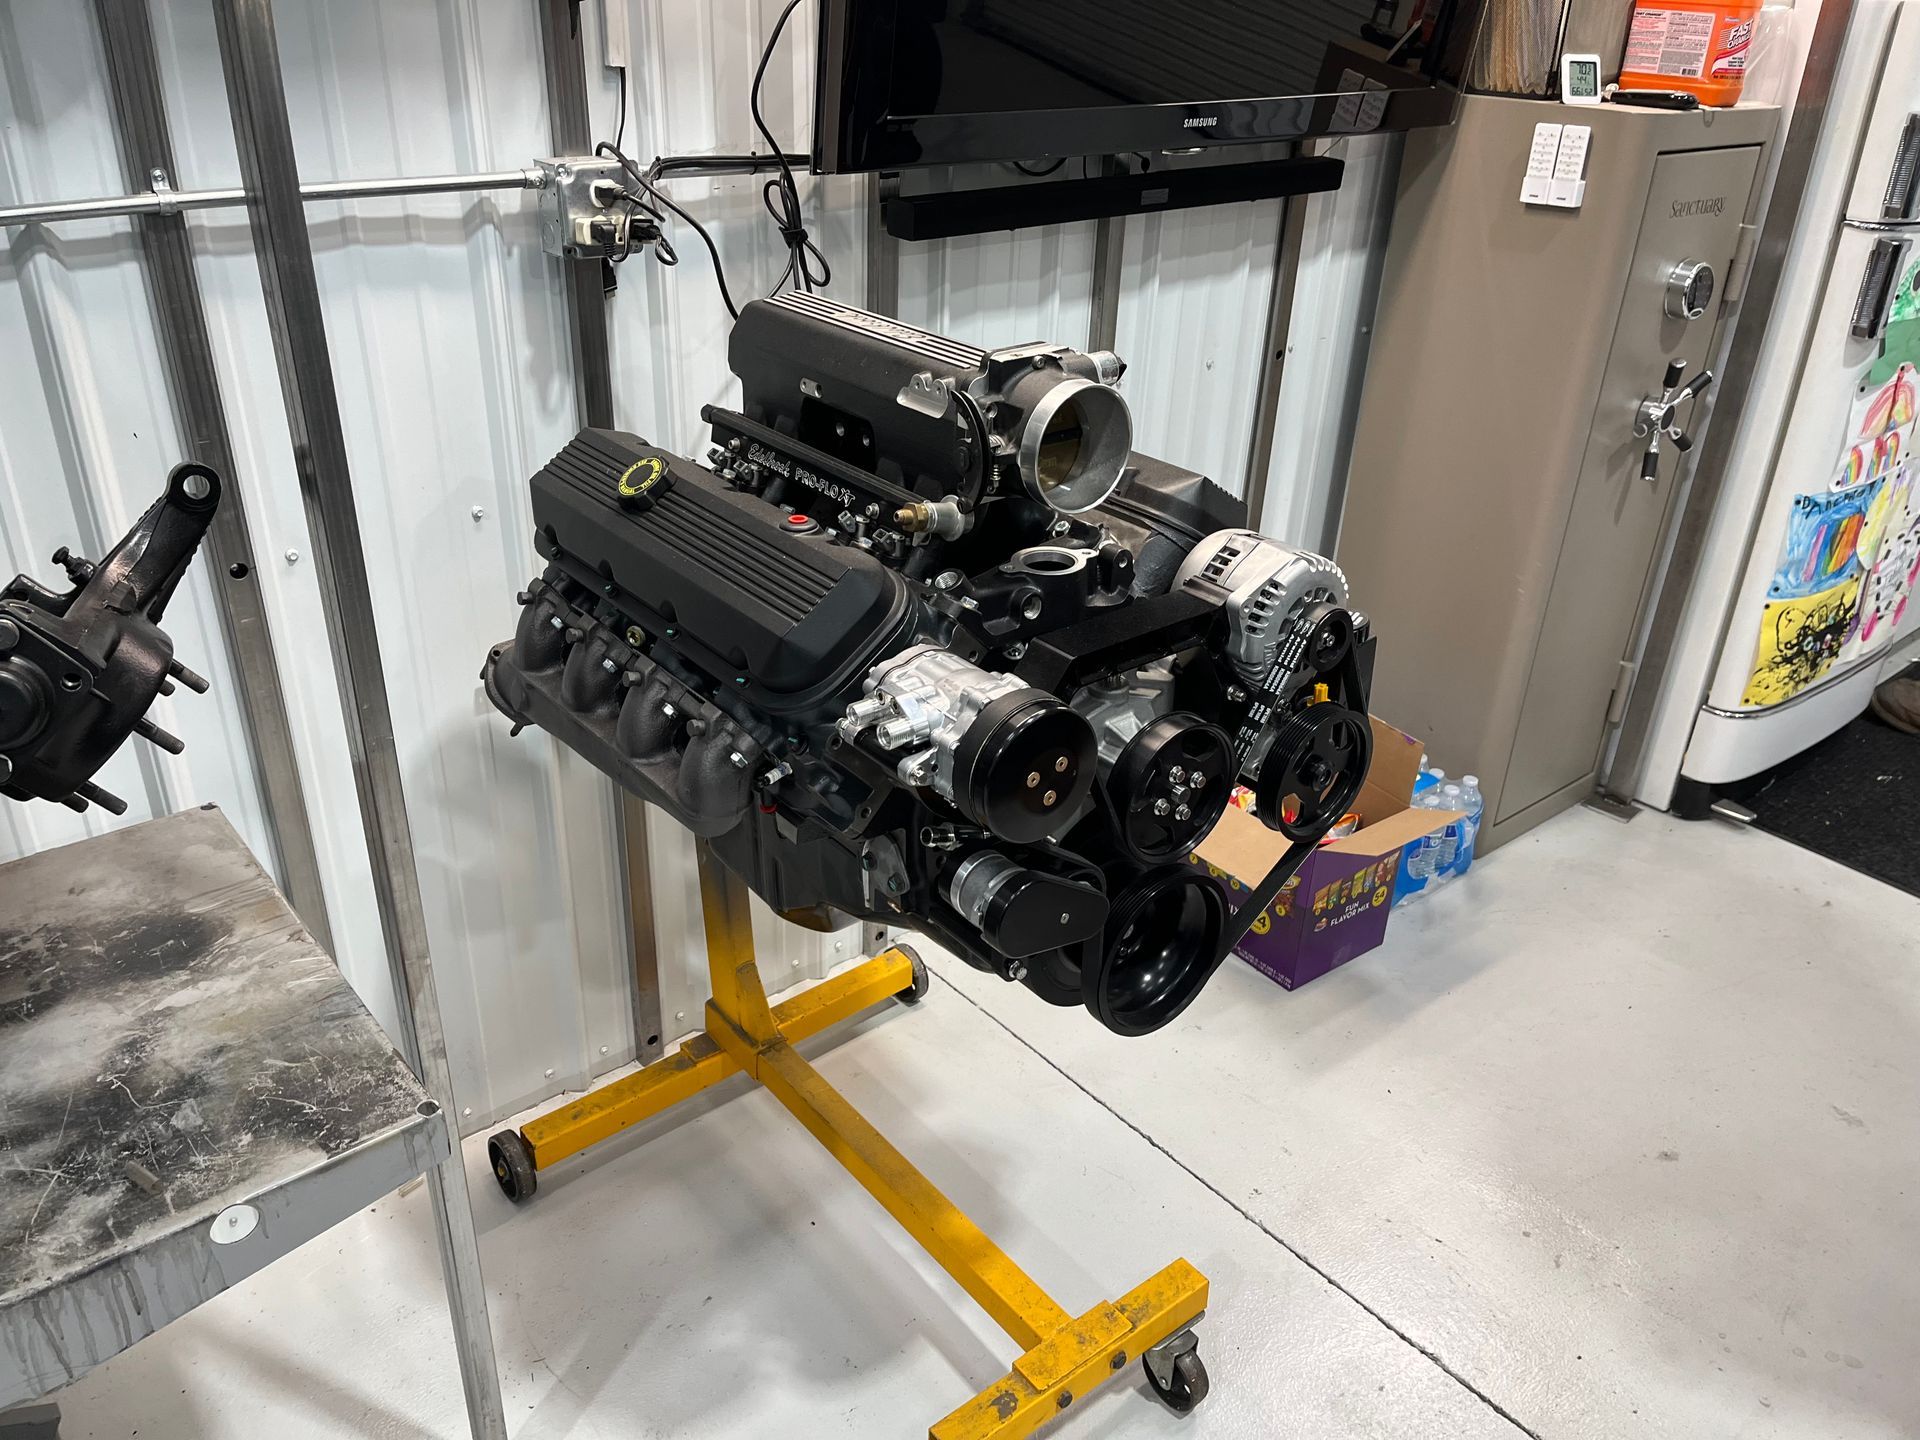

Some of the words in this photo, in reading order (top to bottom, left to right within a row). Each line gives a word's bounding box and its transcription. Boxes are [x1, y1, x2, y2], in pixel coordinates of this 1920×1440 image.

[1183, 116, 1218, 128] SAMSUNG
[1374, 891, 1385, 902] 54
[1344, 900, 1360, 913] FUN
[1330, 909, 1357, 927] FLAVOR
[1357, 902, 1370, 914] MIX
